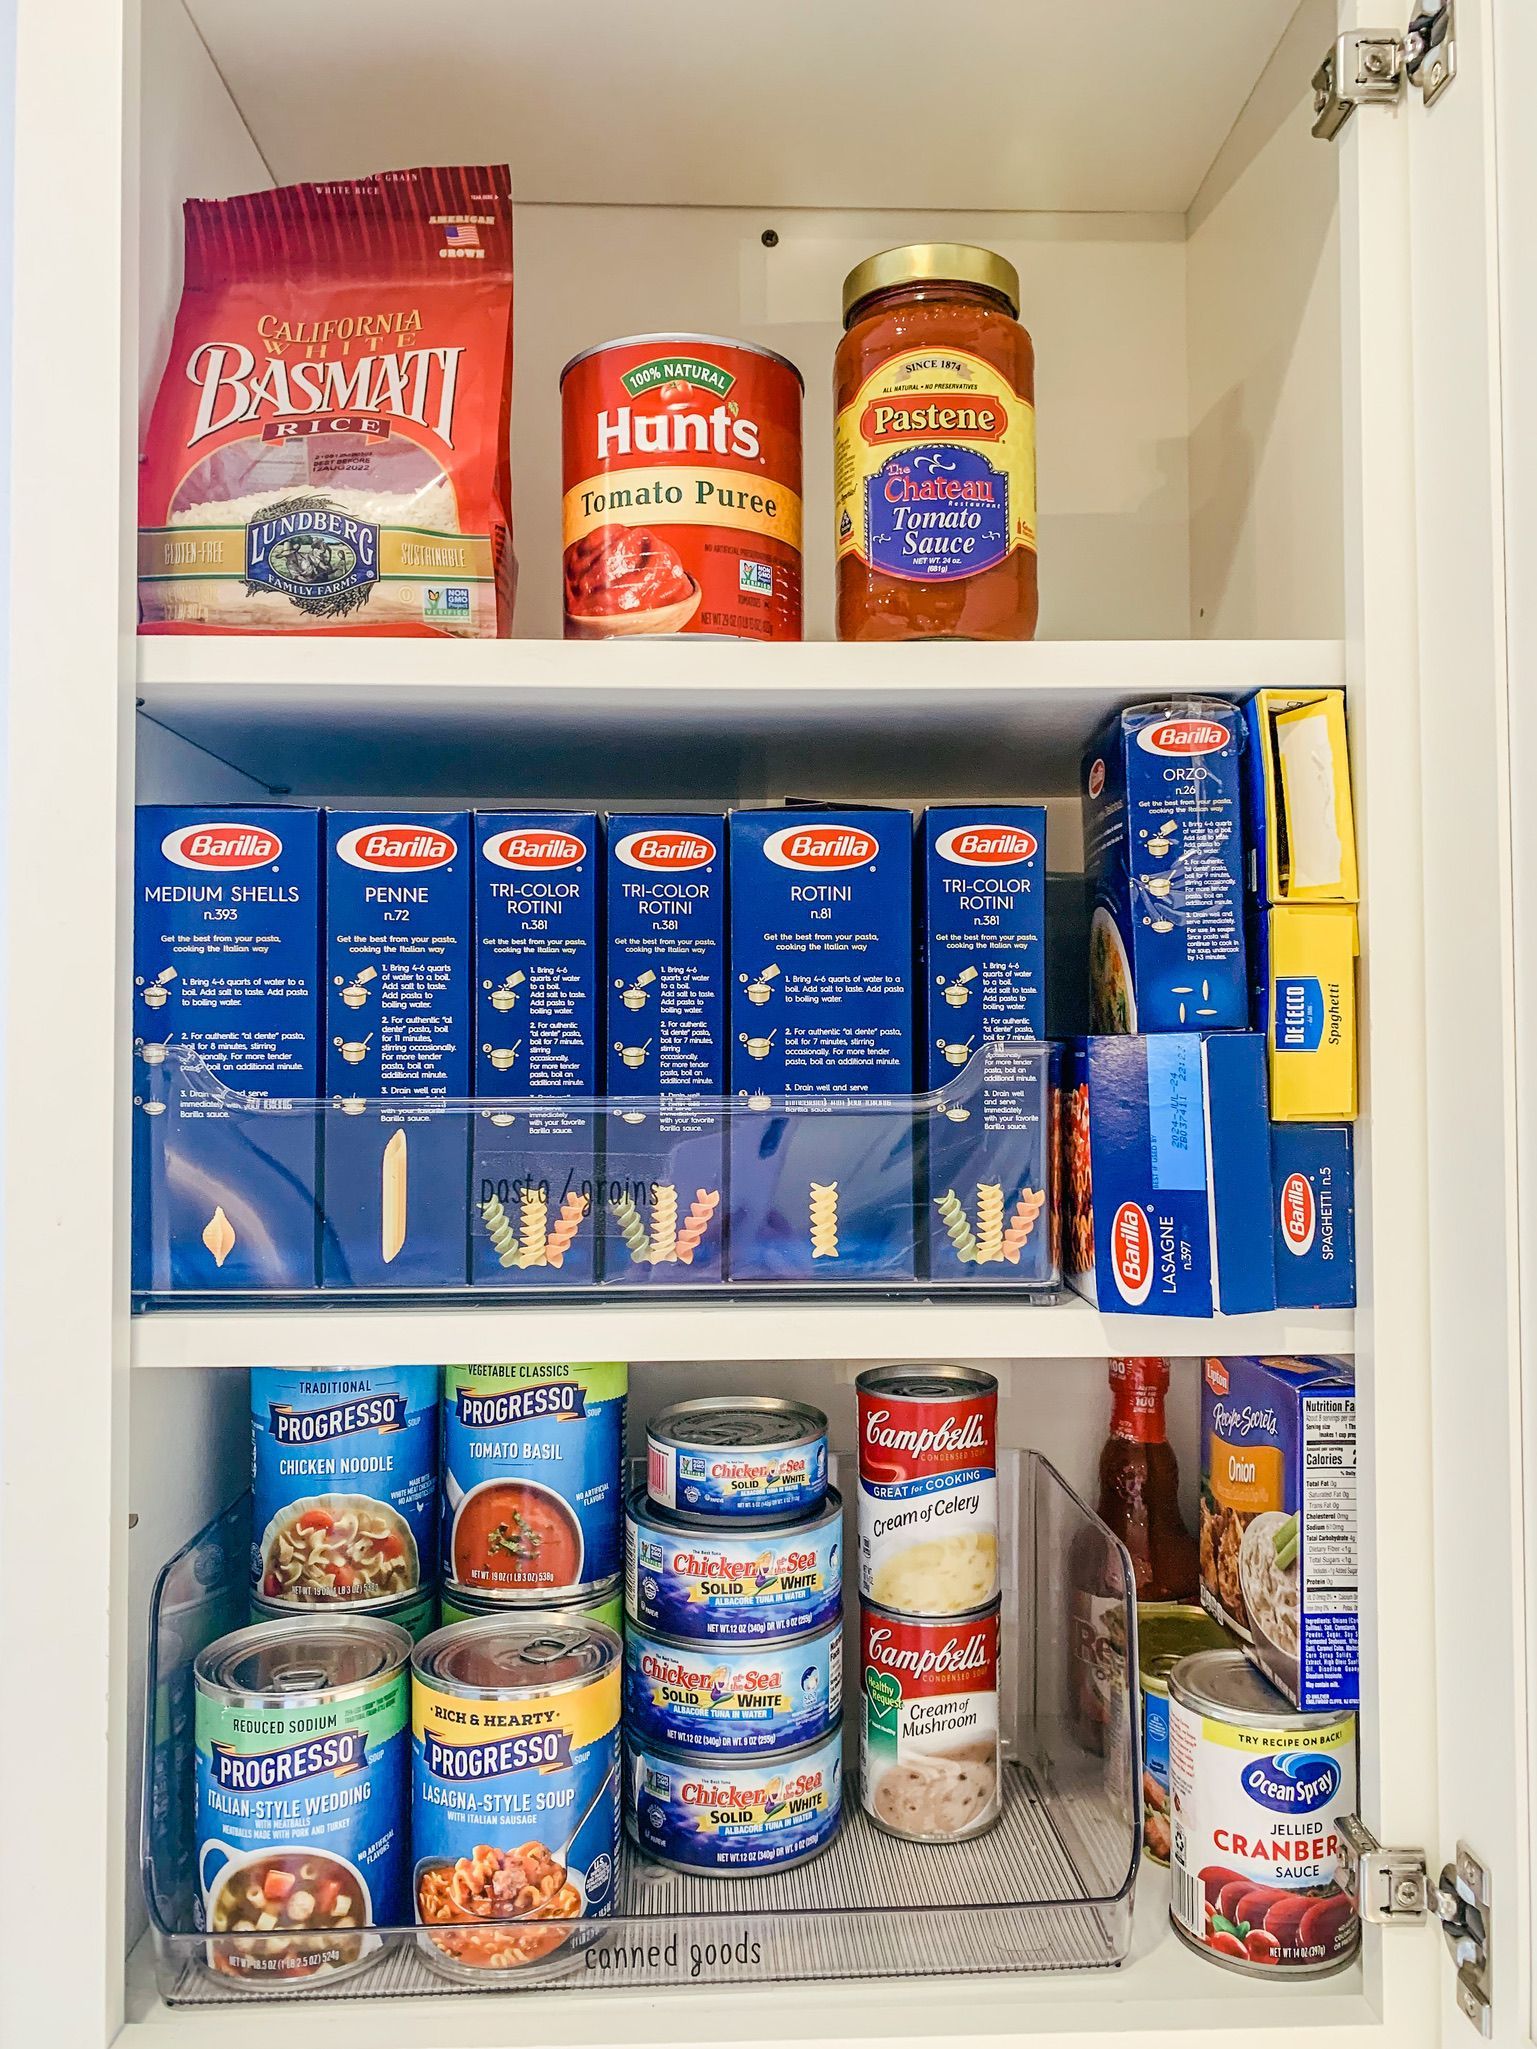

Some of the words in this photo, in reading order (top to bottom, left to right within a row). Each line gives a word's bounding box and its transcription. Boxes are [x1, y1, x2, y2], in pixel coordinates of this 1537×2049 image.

[355, 187, 379, 195] RICE
[429, 216, 495, 225] AMERICAN
[439, 249, 485, 258] GROWN
[258, 309, 423, 342] CALIFORNIA
[263, 334, 417, 359] WHITE
[629, 367, 661, 389] 100%
[664, 363, 726, 390] NATURAL
[905, 360, 938, 373] SINCE
[940, 360, 962, 372] 1874
[186, 342, 466, 450] BASMATI
[894, 384, 919, 392] NATURAL
[275, 419, 381, 437] RICE
[874, 405, 996, 435] Pastene
[886, 464, 910, 476] The
[884, 475, 995, 503] Chateau
[581, 481, 683, 517] Tomato
[695, 481, 777, 518] Puree
[948, 500, 1000, 509] Restaurant
[892, 506, 982, 532] Tomato
[251, 512, 373, 566] LUNDBERG
[902, 532, 975, 556] Sauce
[164, 542, 224, 565] GLUTEN-FREE
[401, 543, 466, 567] SUSTAINABLE
[268, 574, 315, 596] FAMILY
[317, 574, 358, 596] FARMS
[447, 595, 469, 603] GMO
[1159, 725, 1222, 747] Barilla
[1163, 767, 1208, 781] ORZO
[1175, 785, 1196, 795] n.26
[190, 835, 272, 857] Barilla
[364, 836, 447, 858] Barilla
[507, 840, 578, 859] Barilla
[639, 841, 707, 860] Barilla
[791, 836, 870, 858] Barilla
[959, 835, 1030, 855] Barilla
[145, 887, 223, 902] MEDIUM
[231, 886, 299, 902] SHELLS
[365, 887, 429, 903] PENNE
[490, 884, 579, 897] TRI-COLOR
[622, 884, 709, 898] TRI-COLOR
[791, 886, 852, 902] ROTINI
[943, 879, 1031, 893] TRI-COLOR
[507, 900, 562, 914] ROTINI
[639, 901, 692, 914] ROTINI
[960, 896, 1014, 910] ROTINI
[204, 909, 238, 921] n.393
[384, 909, 410, 922] n.72
[810, 908, 832, 920] n.81
[974, 915, 1000, 926] n.381
[521, 920, 548, 930] n.381
[652, 920, 678, 930] n.381
[776, 943, 807, 952] cooking
[851, 944, 867, 952] way
[835, 935, 853, 943] your
[855, 934, 879, 943] pasta,
[1285, 987, 1304, 1025] CECCO
[1328, 984, 1342, 1045] Spaghetti
[1285, 1027, 1304, 1043] DE
[1170, 1072, 1180, 1148] 2024-JUL-24
[1320, 1167, 1332, 1186] n.5
[481, 1174, 550, 1216] pasta
[581, 1177, 659, 1217] grains
[1290, 1180, 1305, 1236] Barilla
[1322, 1192, 1334, 1260] SPAGHETTI
[1120, 1210, 1141, 1281] Barilla
[1160, 1216, 1177, 1294] LASAGNE
[1181, 1240, 1192, 1270] n.397
[468, 1364, 516, 1377] VEGETABLE
[519, 1365, 569, 1377] CLASSICS
[1207, 1364, 1227, 1389] Lipton
[300, 1381, 372, 1394] TRADITIONAL
[463, 1387, 574, 1424] PROGRESSO
[587, 1407, 602, 1418] SOUP
[1306, 1401, 1342, 1411] Nutrition
[278, 1399, 396, 1442] PROGRESSO
[408, 1416, 421, 1428] SOUP
[1213, 1402, 1242, 1436] Recipe
[1240, 1406, 1278, 1436] Secrets
[867, 1410, 985, 1459] Campbell's
[469, 1442, 518, 1459] TOMATO
[523, 1443, 562, 1460] BASIL
[921, 1451, 968, 1462] CONDENSED
[1307, 1454, 1342, 1465] Calories
[280, 1458, 335, 1475] CHICKEN
[340, 1456, 394, 1474] NOODLE
[1228, 1456, 1256, 1482] Onion
[874, 1486, 908, 1497] GREAT
[911, 1486, 923, 1494] for
[926, 1470, 980, 1490] COOKING
[874, 1510, 917, 1537] Cream
[920, 1505, 933, 1522] of
[935, 1495, 979, 1516] Celery
[673, 1554, 757, 1579] Chicken
[786, 1550, 817, 1572] Sea
[701, 1582, 743, 1595] SOLID
[781, 1574, 817, 1589] WHITE
[715, 1596, 753, 1606] ALBACORE
[754, 1594, 774, 1603] TUNA
[776, 1593, 782, 1601] IN
[784, 1590, 806, 1601] WATER
[869, 1627, 986, 1679] Campbell's
[642, 1655, 715, 1691] Chicken
[744, 1671, 782, 1689] Sea
[869, 1676, 894, 1697] Healthy
[662, 1687, 699, 1705] SOLID
[737, 1694, 782, 1707] WHITE
[872, 1690, 903, 1710] Request
[434, 1707, 467, 1724] RICH
[469, 1713, 479, 1725] &
[483, 1711, 555, 1728] HEARTY
[910, 1701, 957, 1720] Cream
[959, 1699, 970, 1713] of
[233, 1717, 286, 1735] REDUCED
[289, 1714, 337, 1733] SODIUM
[903, 1713, 977, 1738] Mushroom
[1238, 1734, 1259, 1744] TRY
[1262, 1737, 1300, 1747] RECIPE
[1302, 1737, 1318, 1746] ON
[1320, 1730, 1343, 1744] BACK!
[220, 1736, 354, 1786] PROGRESSO
[368, 1749, 384, 1765] SOUP
[431, 1735, 559, 1777] PROGRESSO
[574, 1750, 590, 1766] SOUP
[422, 1781, 530, 1812] LASAGNA-STYLE
[535, 1789, 575, 1809] SOUP
[1248, 1769, 1295, 1802] Ocean
[1297, 1769, 1334, 1805] Spray
[208, 1789, 300, 1820] ITALIAN-STYLE
[305, 1782, 371, 1816] WEDDING
[447, 1812, 465, 1823] WITH
[466, 1814, 497, 1824] ITALIAN
[499, 1814, 537, 1825] SAUSAGE
[1270, 1822, 1323, 1836] JELLIED
[1212, 1829, 1339, 1862] CRANBER
[1276, 1866, 1320, 1879] SAUCE
[585, 1933, 678, 1969] canned
[691, 1931, 761, 1977] goods
[1269, 1947, 1282, 1957] NET
[1283, 1948, 1292, 1957] WT
[1293, 1947, 1299, 1957] 14
[1300, 1947, 1308, 1957] OZ
[1309, 1945, 1326, 1957] (397g)
